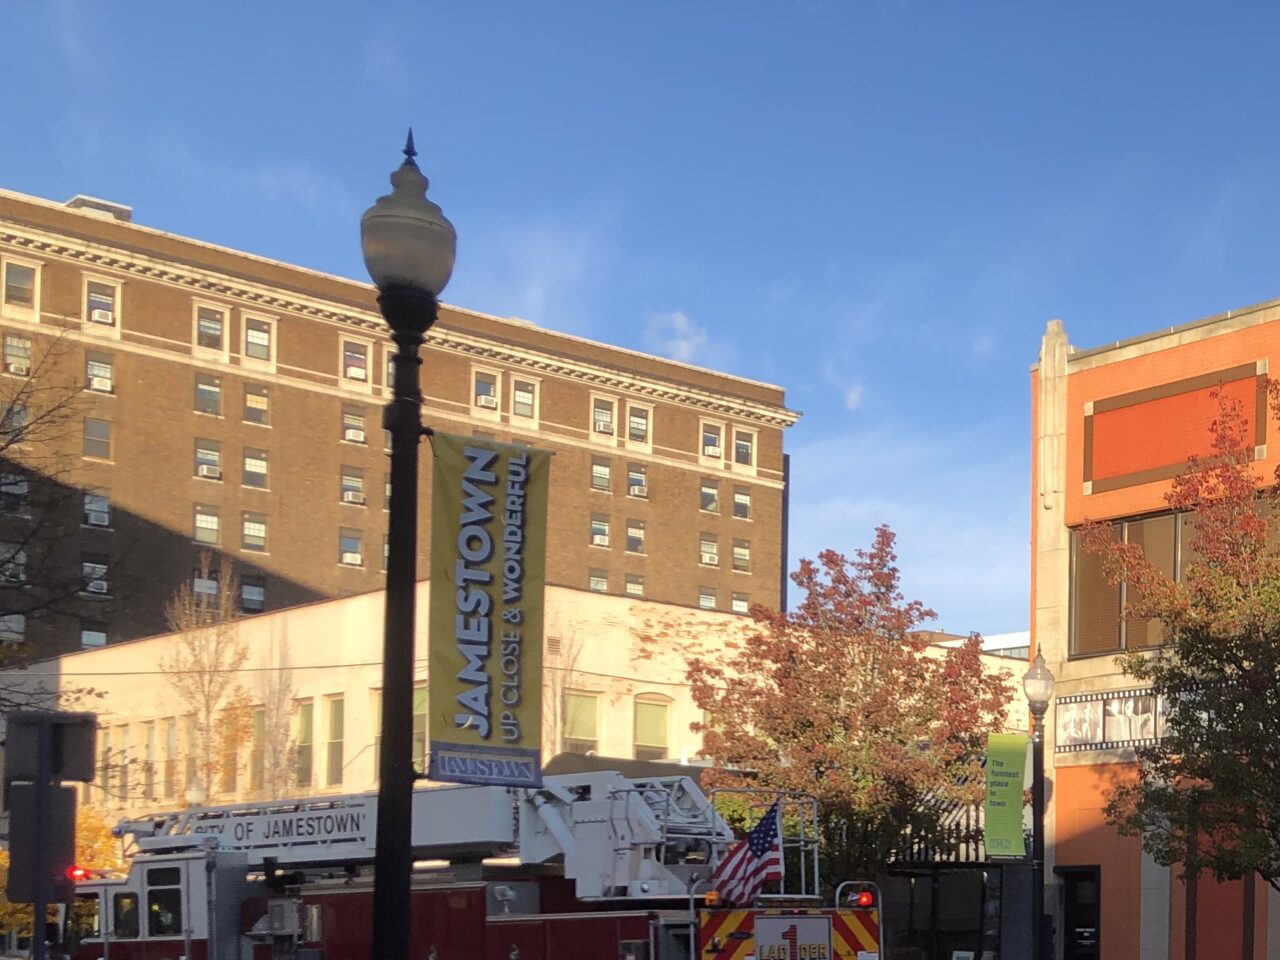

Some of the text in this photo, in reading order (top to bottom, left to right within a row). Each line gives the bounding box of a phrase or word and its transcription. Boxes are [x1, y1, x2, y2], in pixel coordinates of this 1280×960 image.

[455, 446, 498, 738] JAMESTOWN
[501, 453, 528, 740] UP CLOSE & WONDERFUL
[234, 822, 254, 842] OF
[263, 812, 361, 839] JAMESTOWN
